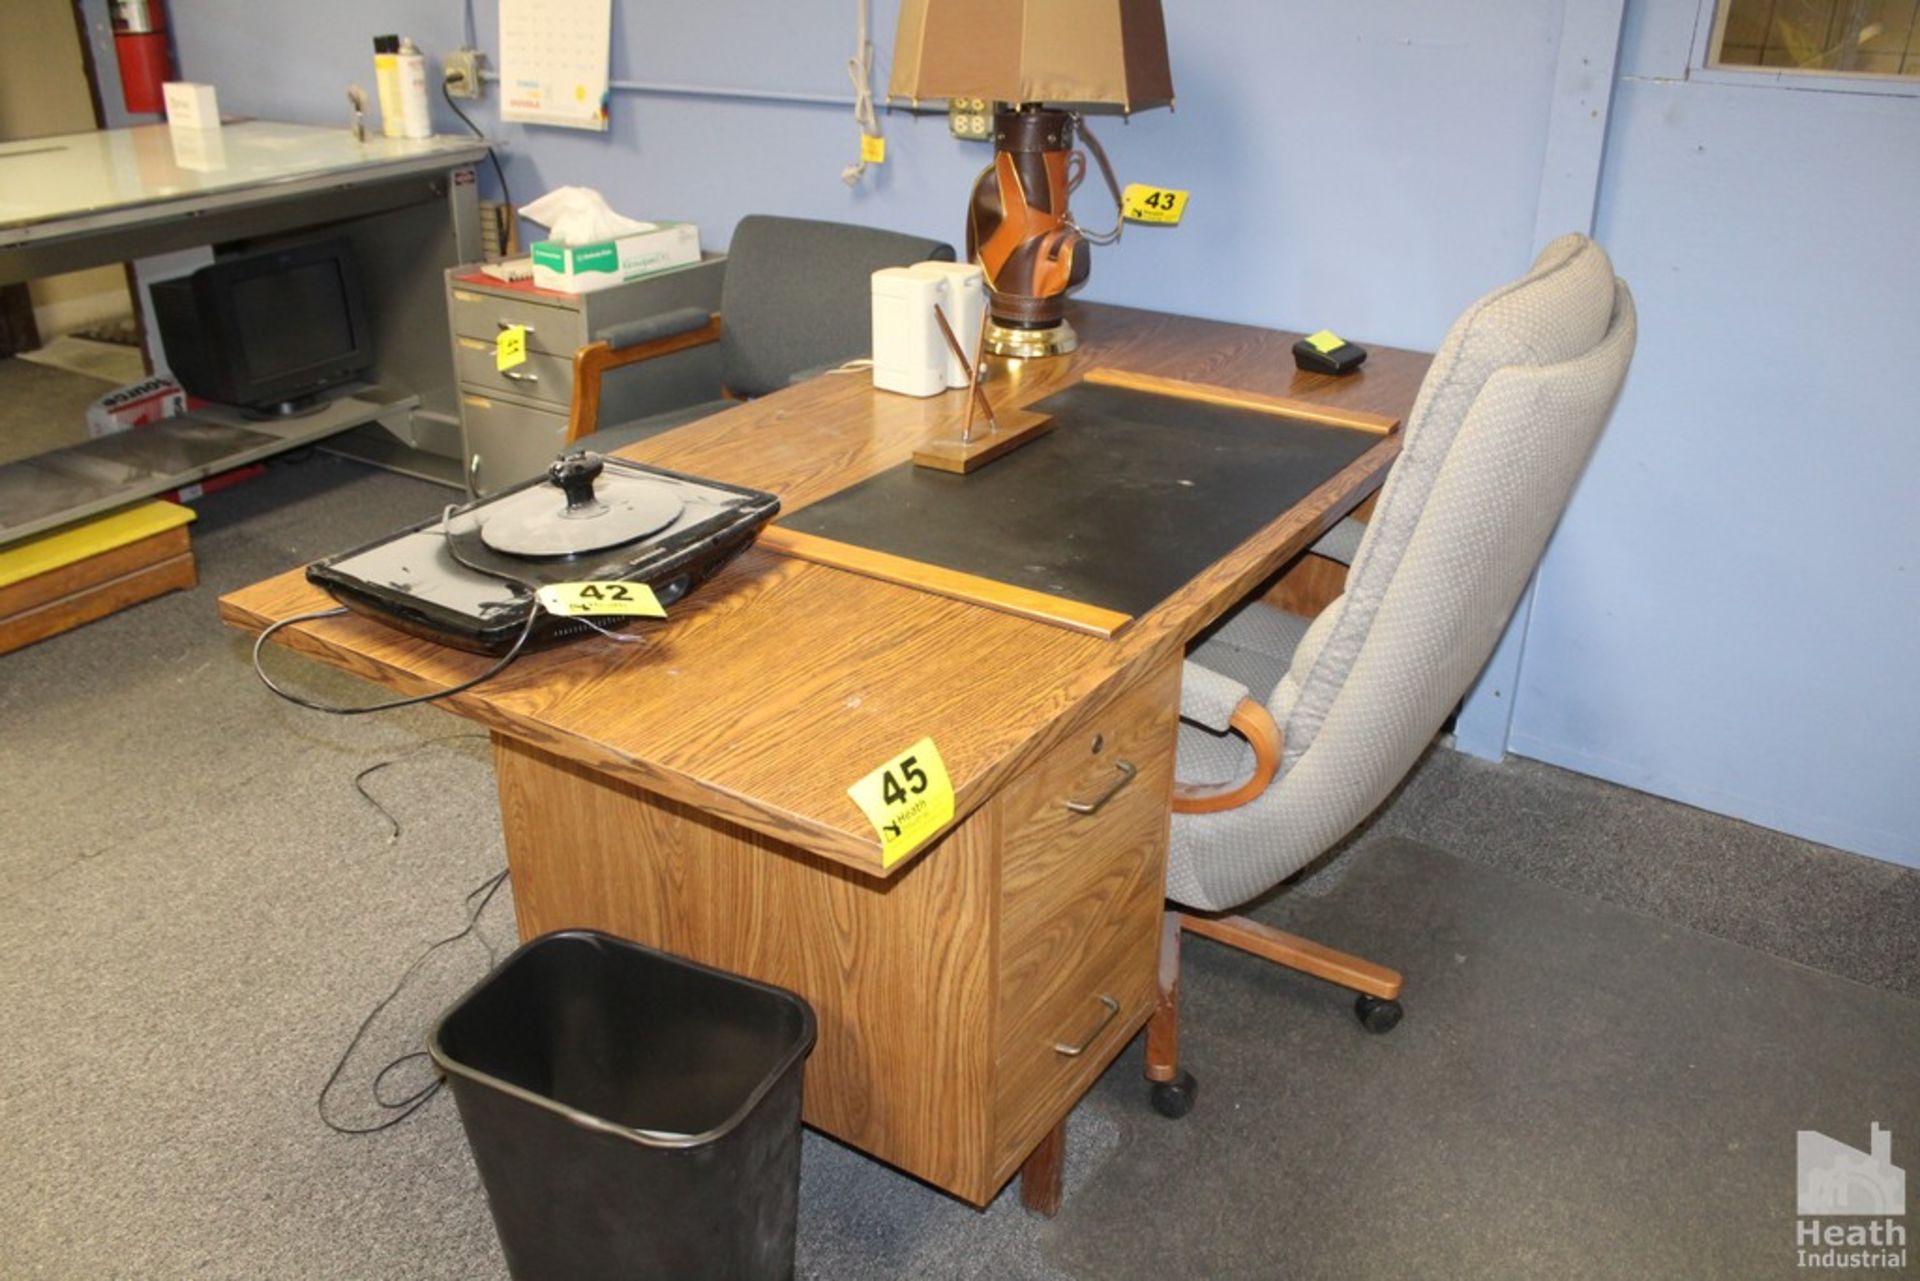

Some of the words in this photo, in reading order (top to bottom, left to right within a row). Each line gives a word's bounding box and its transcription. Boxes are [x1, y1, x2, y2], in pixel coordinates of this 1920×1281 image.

[1144, 190, 1176, 211] 43
[579, 584, 634, 601] 42
[882, 755, 928, 806] 45
